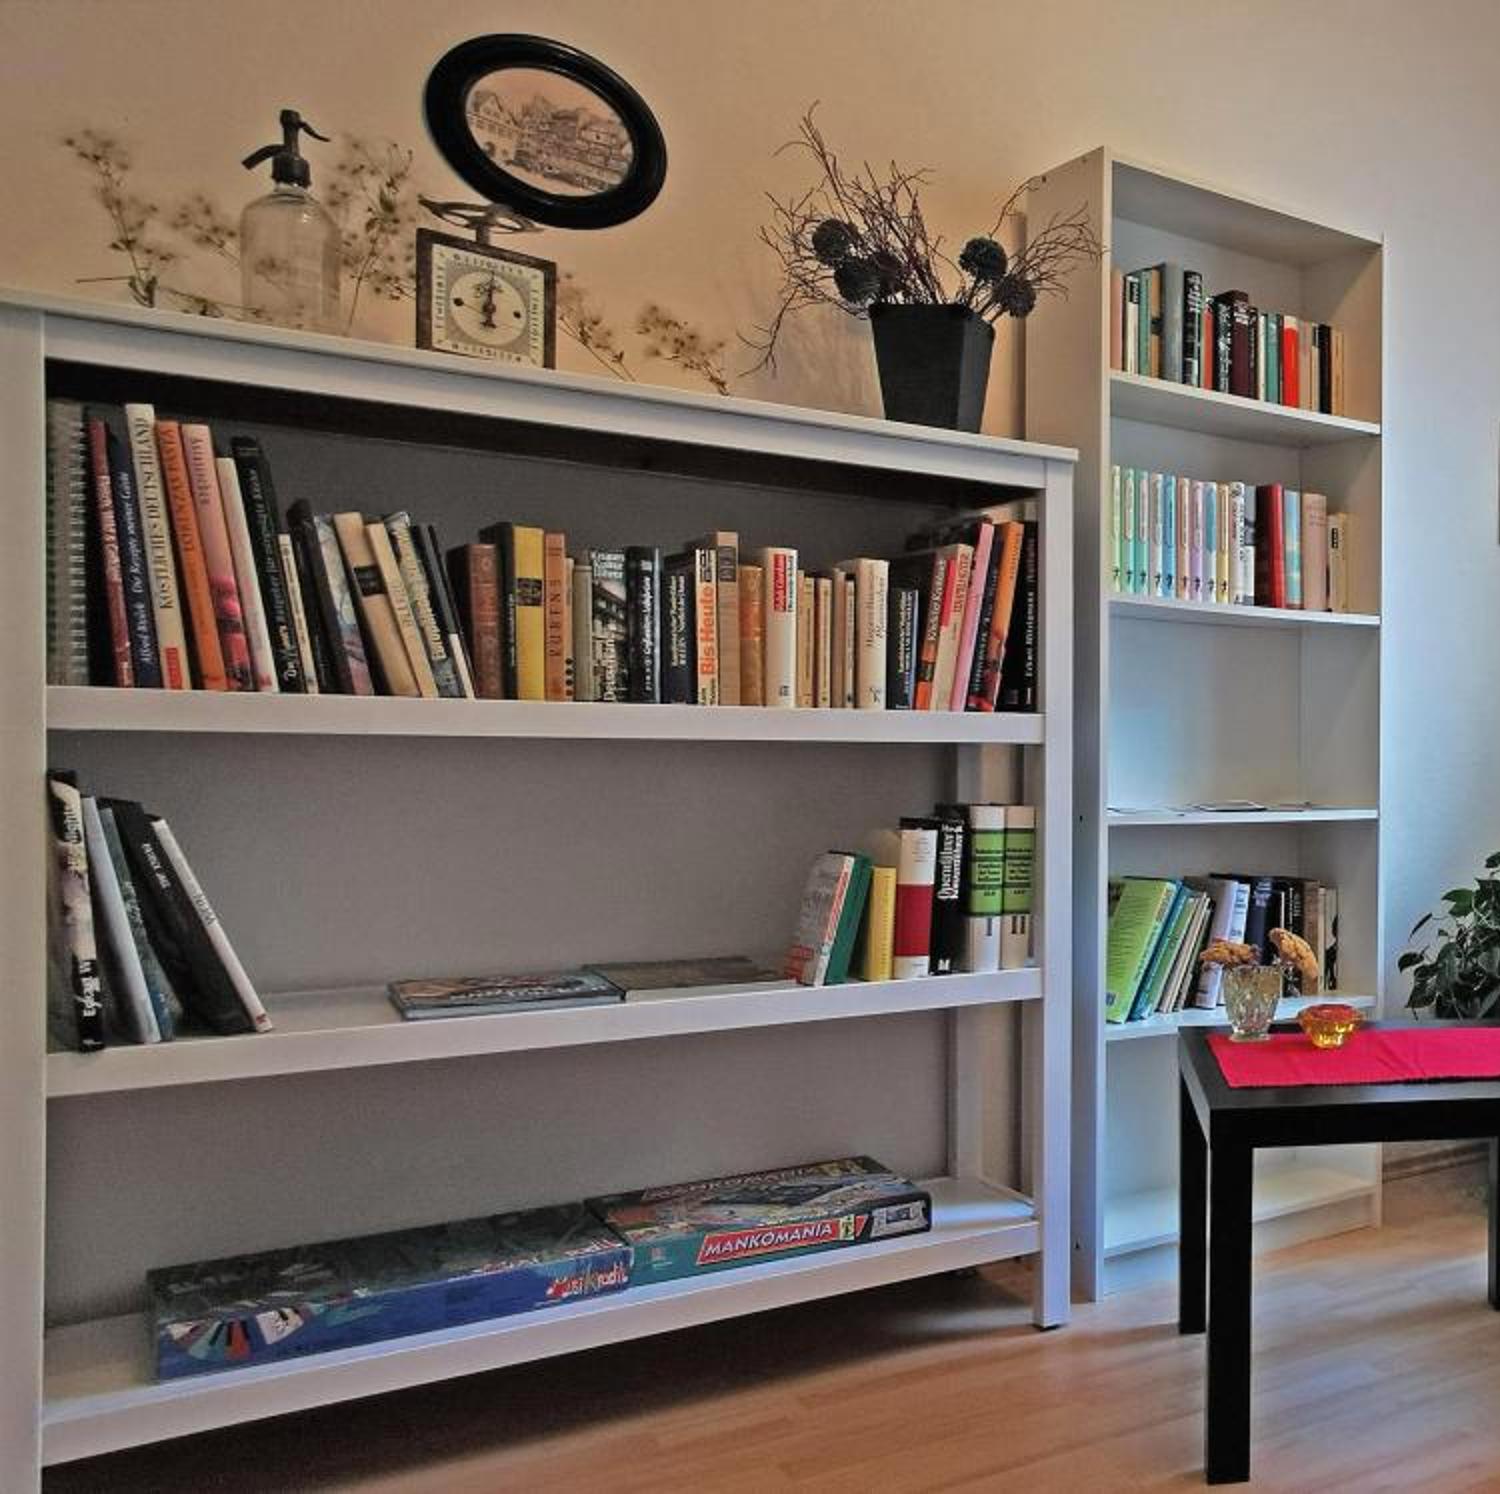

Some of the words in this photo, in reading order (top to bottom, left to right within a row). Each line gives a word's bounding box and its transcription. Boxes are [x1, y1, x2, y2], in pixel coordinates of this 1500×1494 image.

[135, 417, 162, 520] DEUTSCHLAND
[698, 585, 714, 641] Heute
[699, 644, 715, 674] Bis
[703, 1223, 833, 1258] MANKOMANIA
